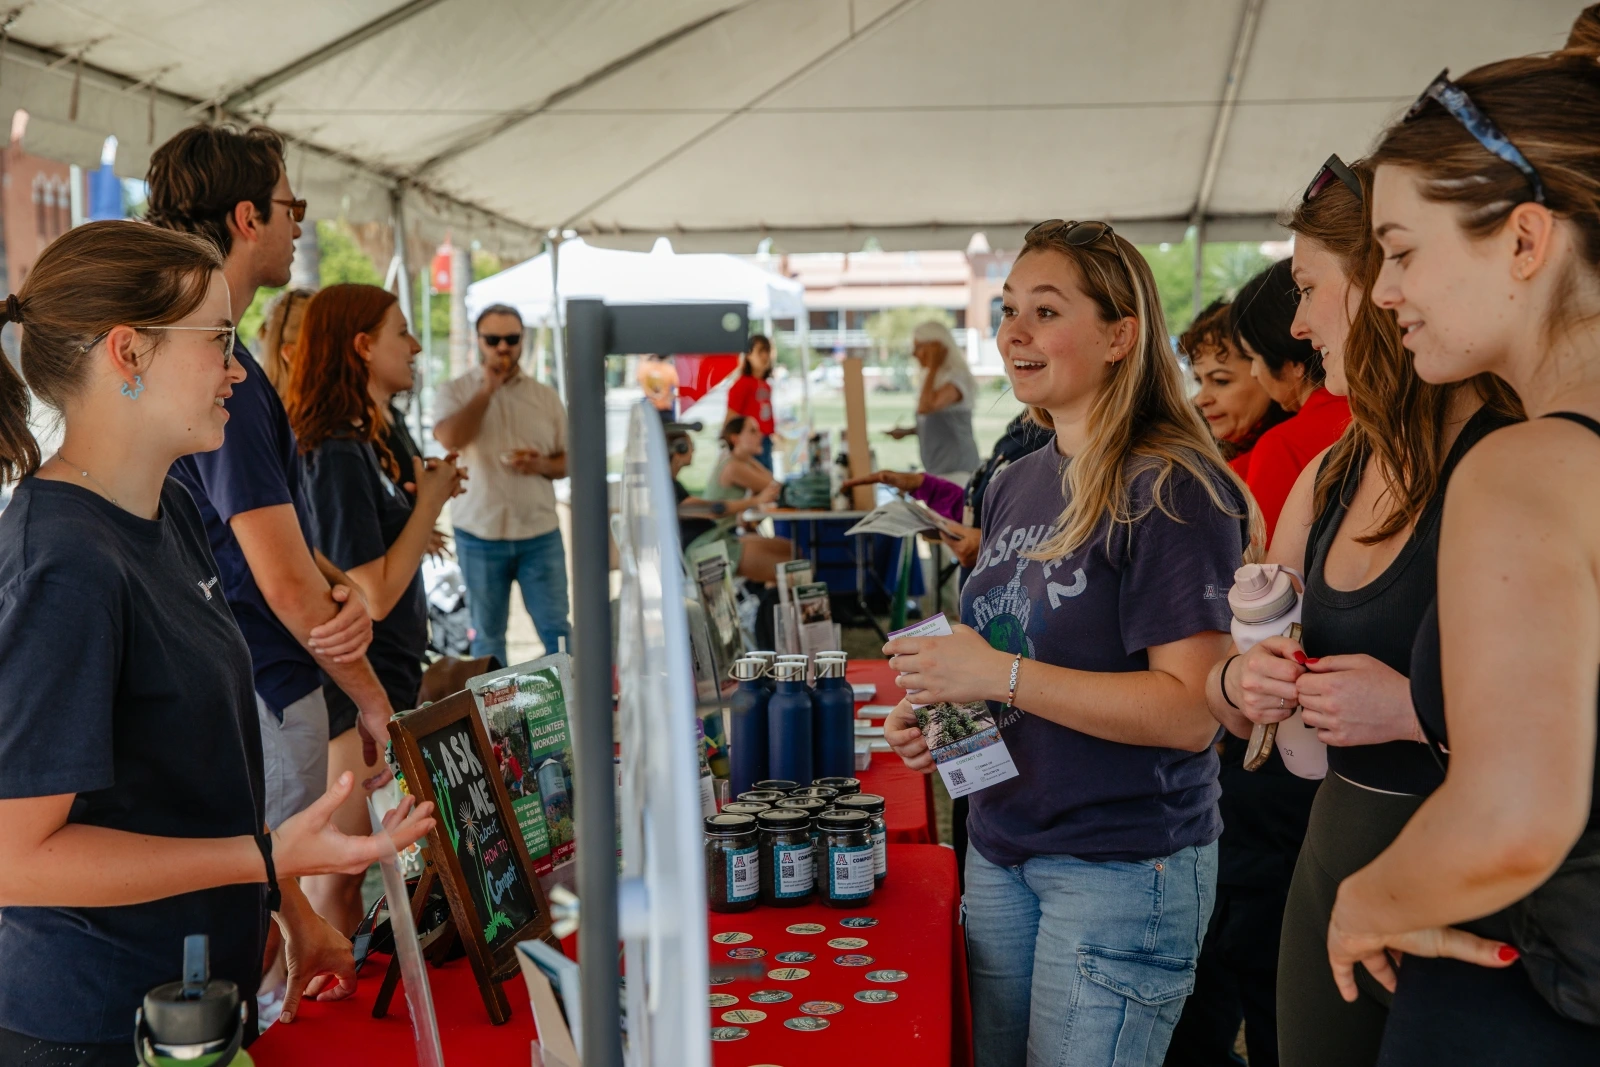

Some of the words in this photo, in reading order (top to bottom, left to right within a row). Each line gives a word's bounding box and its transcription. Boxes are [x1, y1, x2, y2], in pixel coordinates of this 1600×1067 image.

[1046, 567, 1088, 610] 2
[527, 705, 553, 721] GARDEN
[530, 719, 565, 738] VOLUNTEER
[532, 731, 566, 750] WORKDAYS
[438, 731, 483, 788] ASK
[956, 754, 976, 766] CONTACT
[468, 777, 496, 820] ME
[478, 818, 500, 845] about
[483, 848, 499, 867] HOW
[497, 838, 509, 853] TO
[486, 858, 518, 905] Compost
